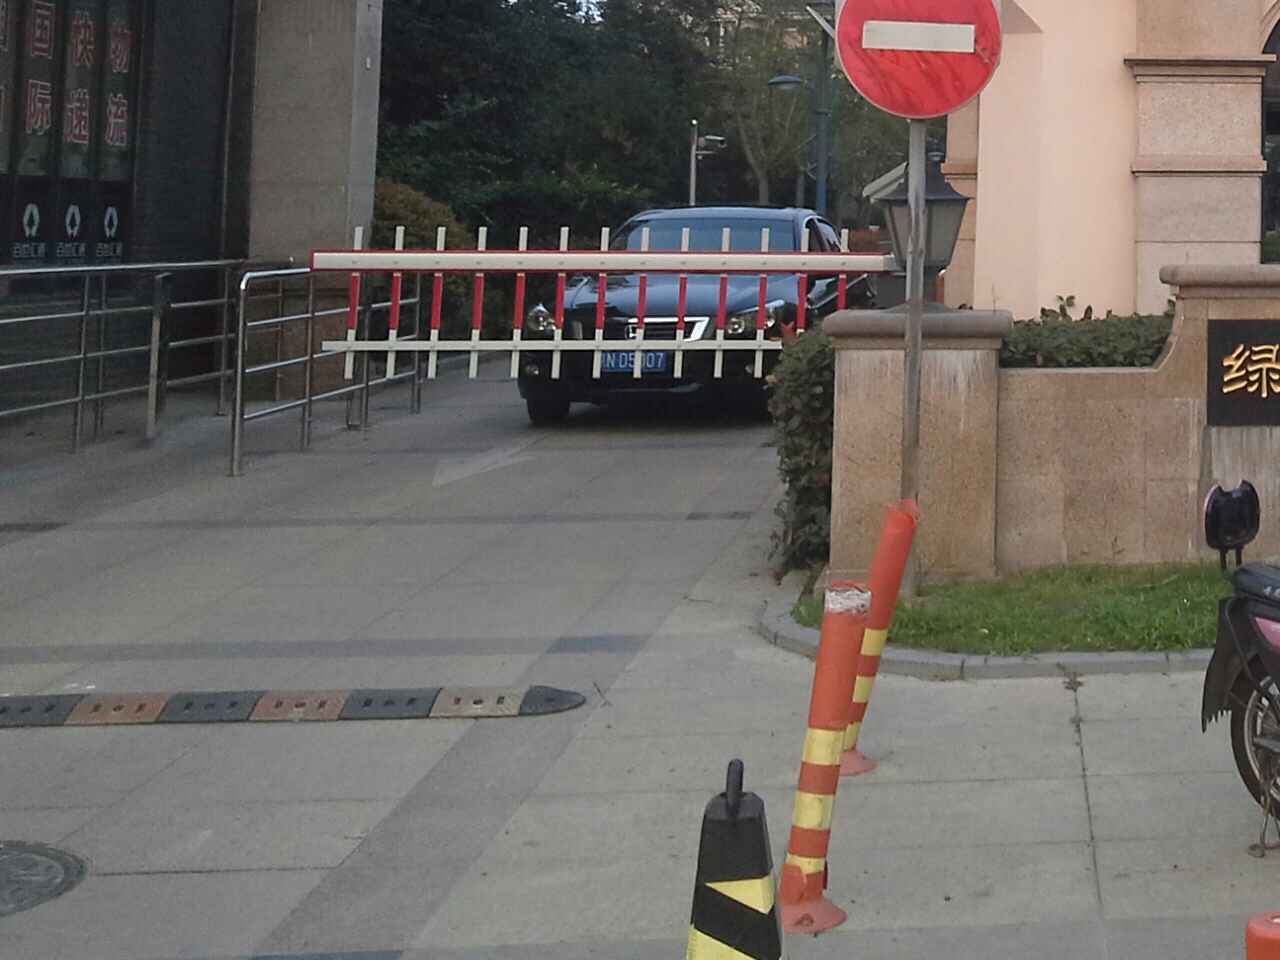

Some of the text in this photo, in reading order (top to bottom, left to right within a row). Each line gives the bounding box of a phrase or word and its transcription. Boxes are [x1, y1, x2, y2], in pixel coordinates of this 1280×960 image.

[25, 0, 56, 136] 国际
[64, 9, 96, 145] 快递
[105, 17, 134, 147] 物流
